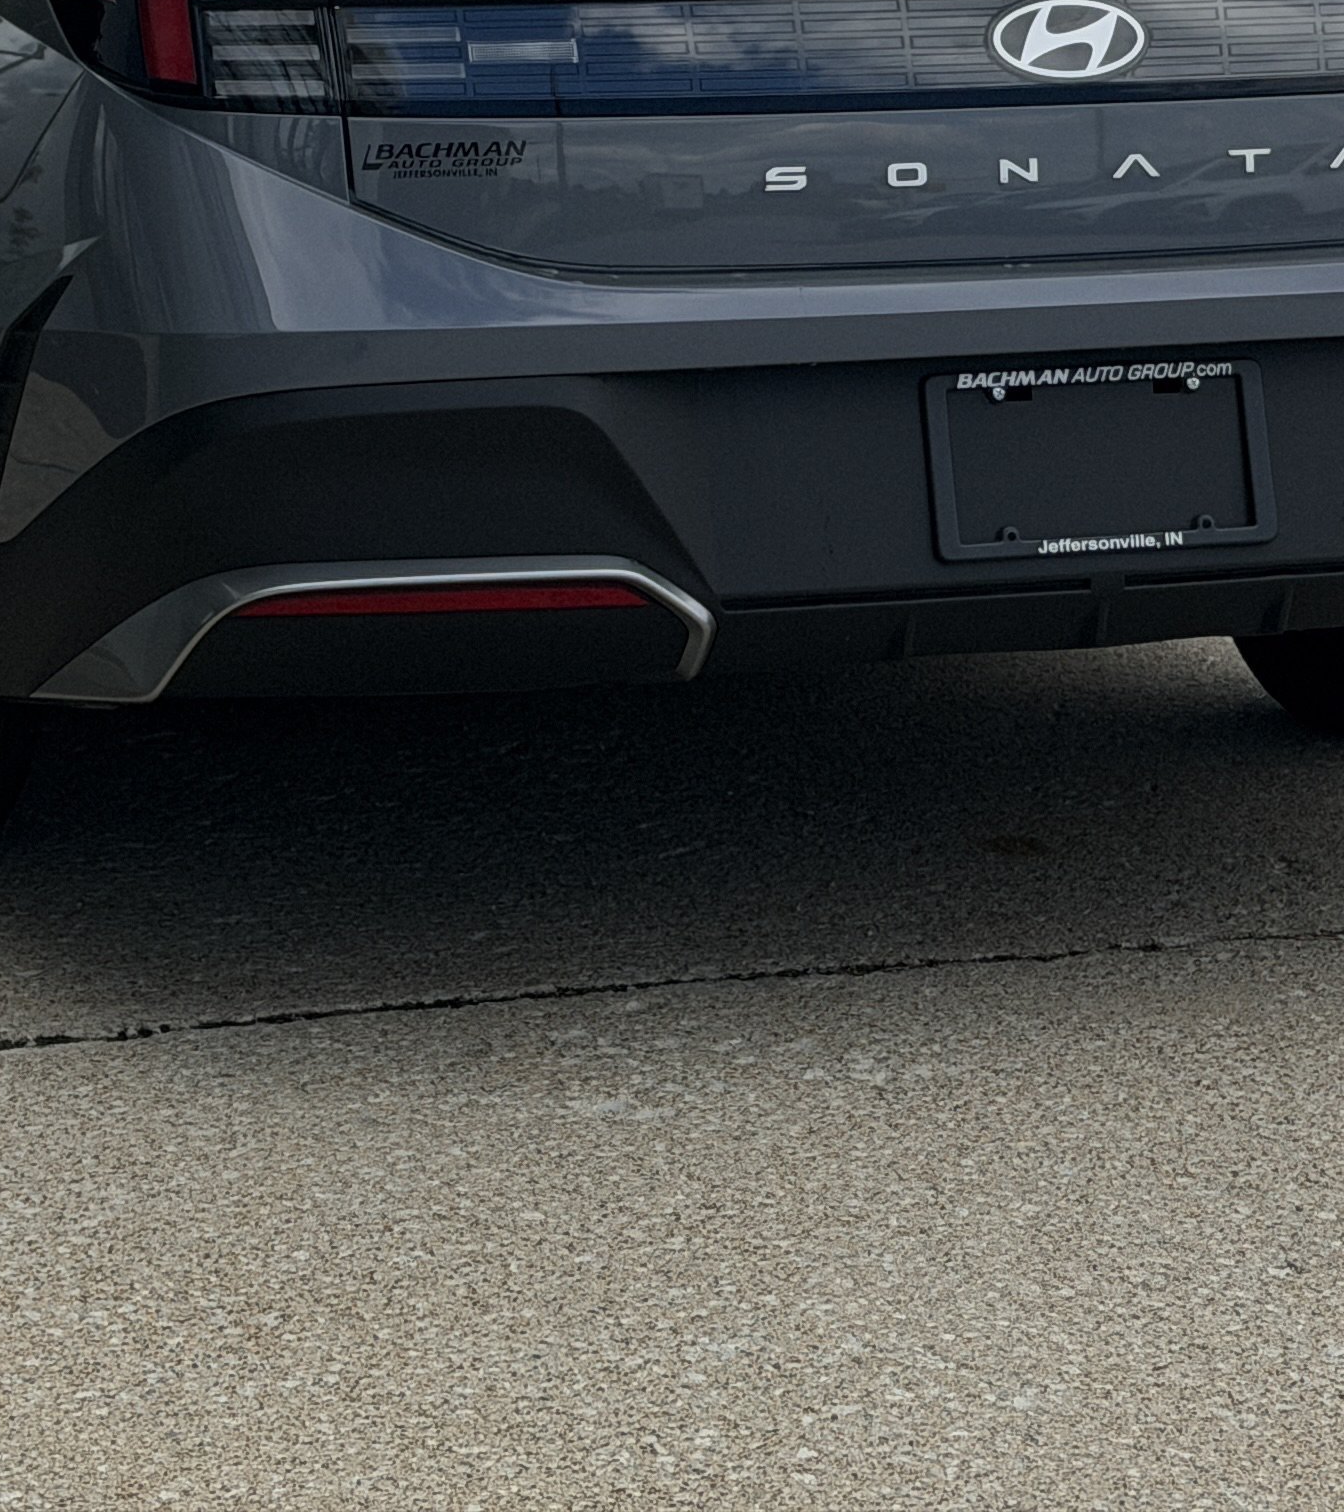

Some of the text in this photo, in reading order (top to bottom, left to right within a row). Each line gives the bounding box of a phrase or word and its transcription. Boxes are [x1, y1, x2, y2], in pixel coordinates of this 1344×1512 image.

[375, 140, 527, 160] BACHMAN
[387, 157, 523, 169] AUTO GROUP
[957, 361, 1233, 389] BACHMAN AUTO GROUP.com
[1037, 531, 1184, 554] Jeffersonville, IN
